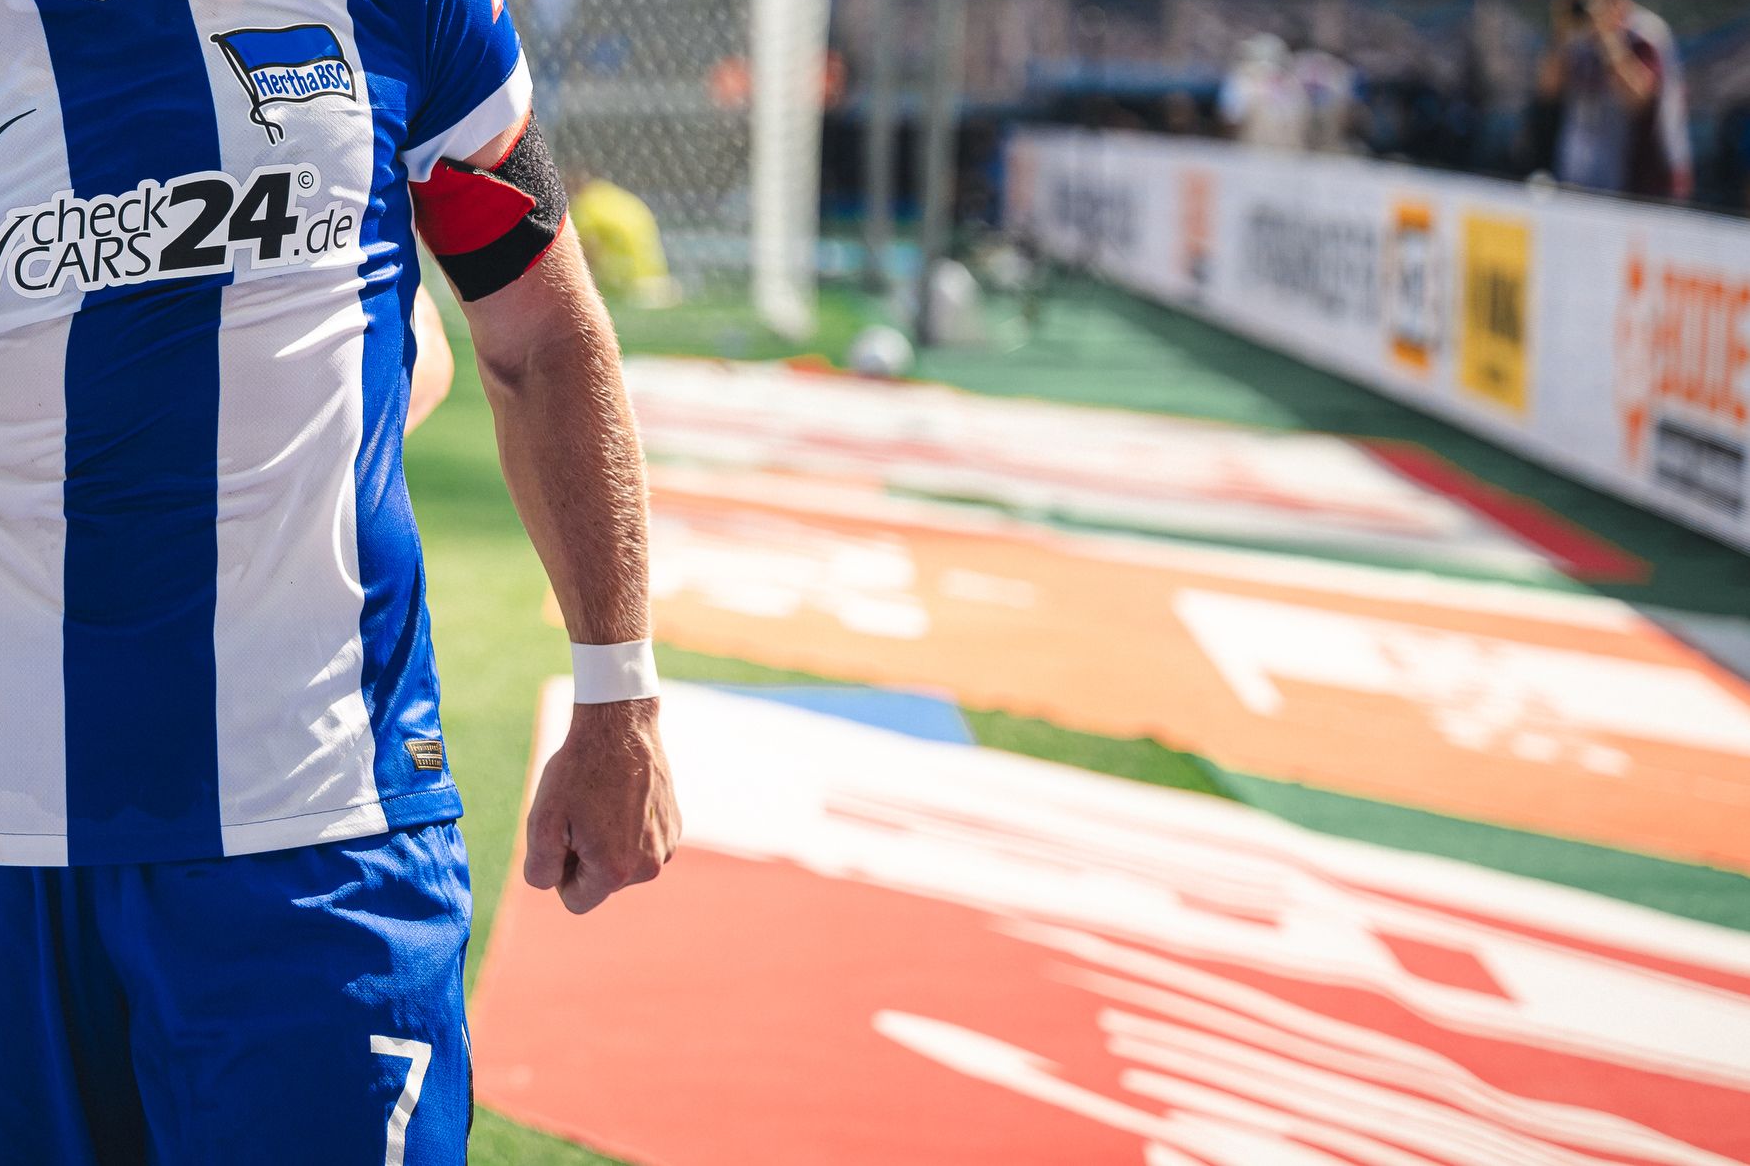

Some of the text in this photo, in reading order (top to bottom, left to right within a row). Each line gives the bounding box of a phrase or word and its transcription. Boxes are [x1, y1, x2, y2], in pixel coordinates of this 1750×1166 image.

[31, 187, 169, 246] check
[14, 232, 152, 290] CARS
[369, 1034, 432, 1165] 7
